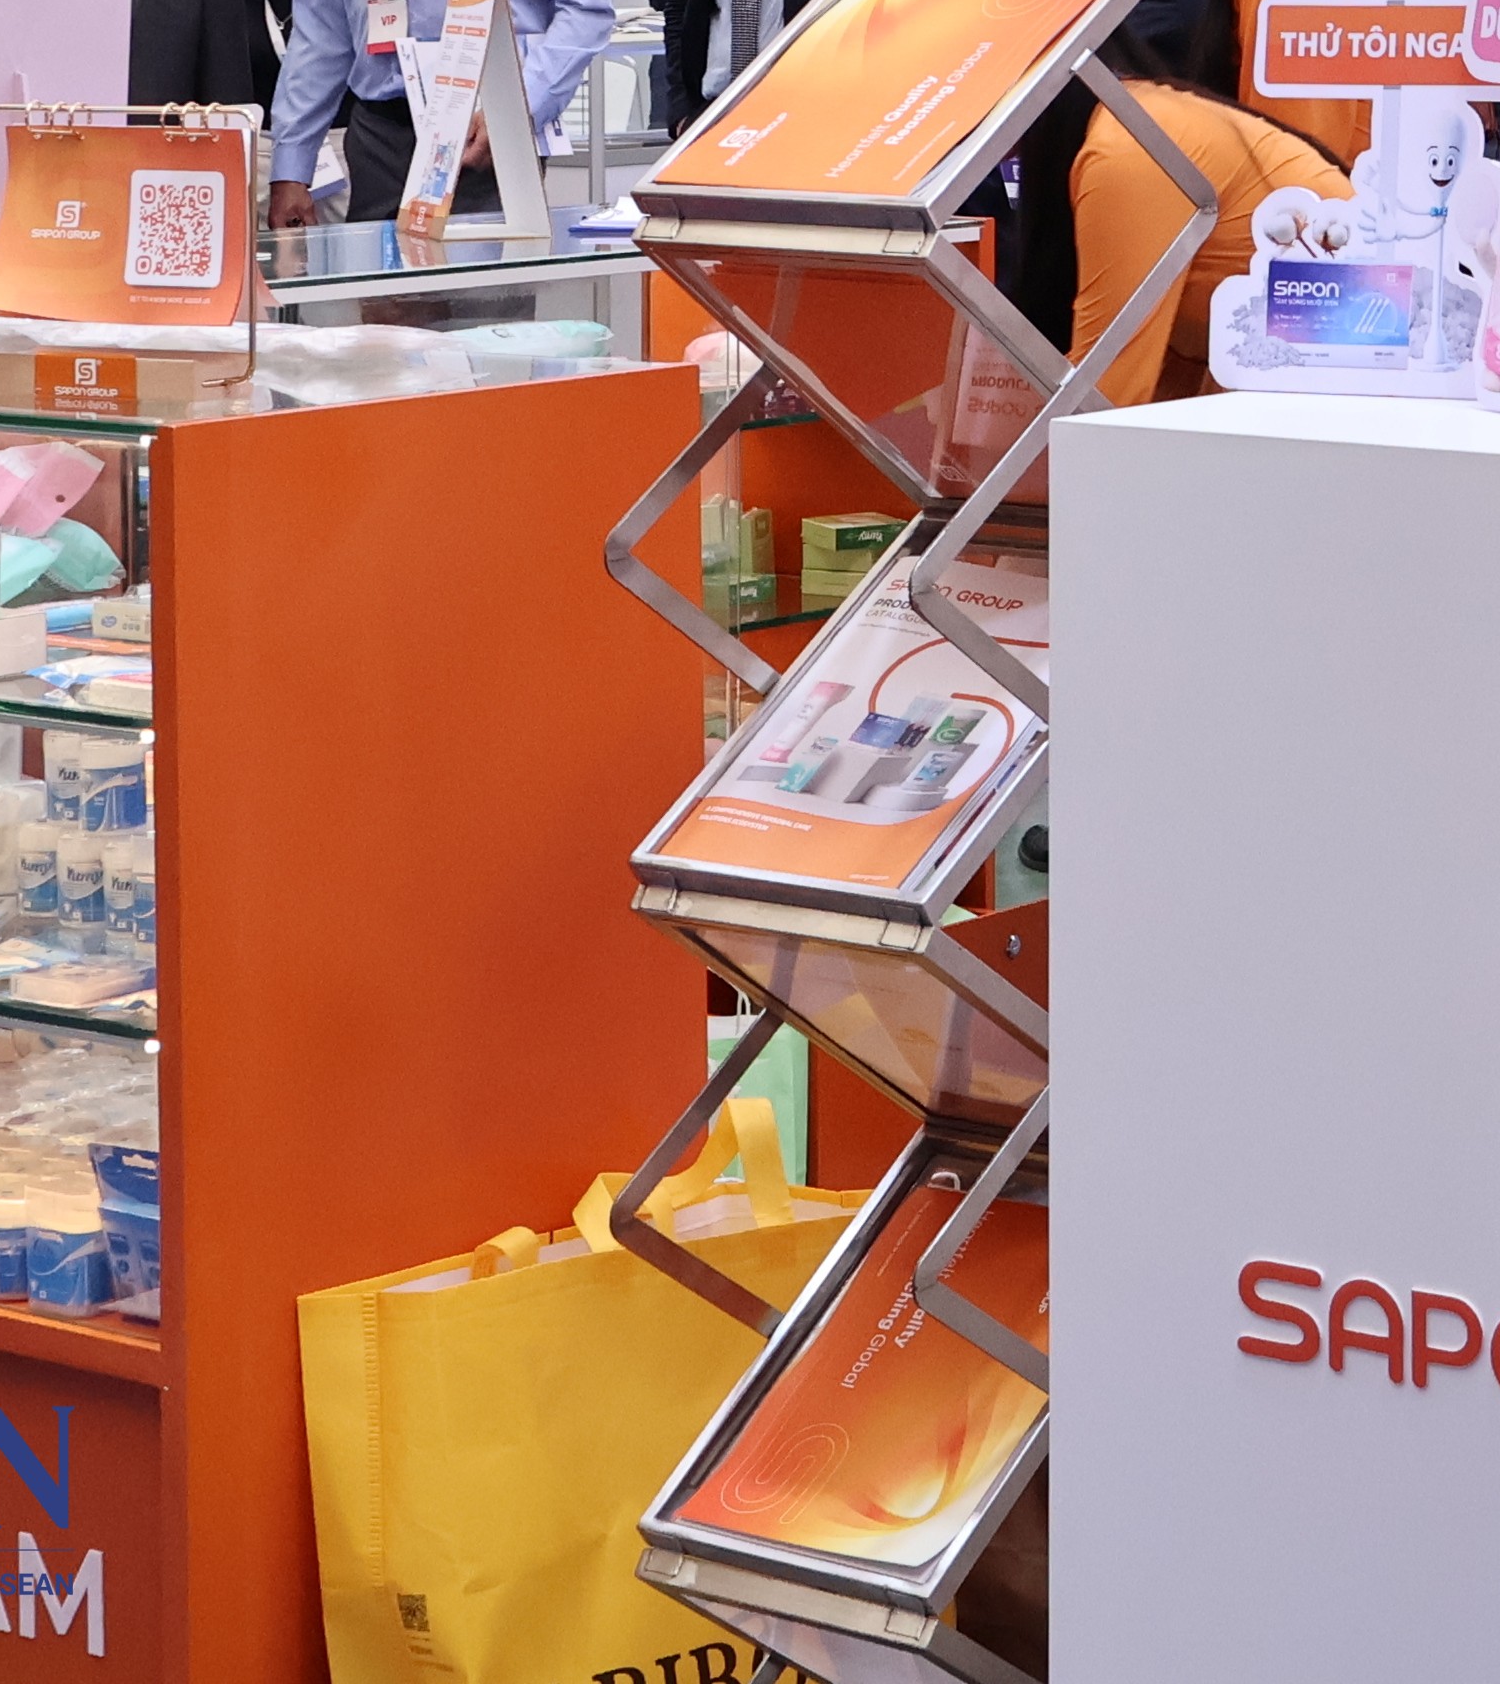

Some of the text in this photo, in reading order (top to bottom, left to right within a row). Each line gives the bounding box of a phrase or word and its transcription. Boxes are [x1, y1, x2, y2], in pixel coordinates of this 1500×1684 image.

[380, 14, 398, 27] VIP
[1280, 21, 1398, 58] THỬ TÔI
[883, 85, 957, 147] Reaching
[946, 41, 994, 86] Global
[883, 73, 939, 124] Quality
[1272, 280, 1341, 298] SAPON
[956, 588, 1025, 613] GROUP
